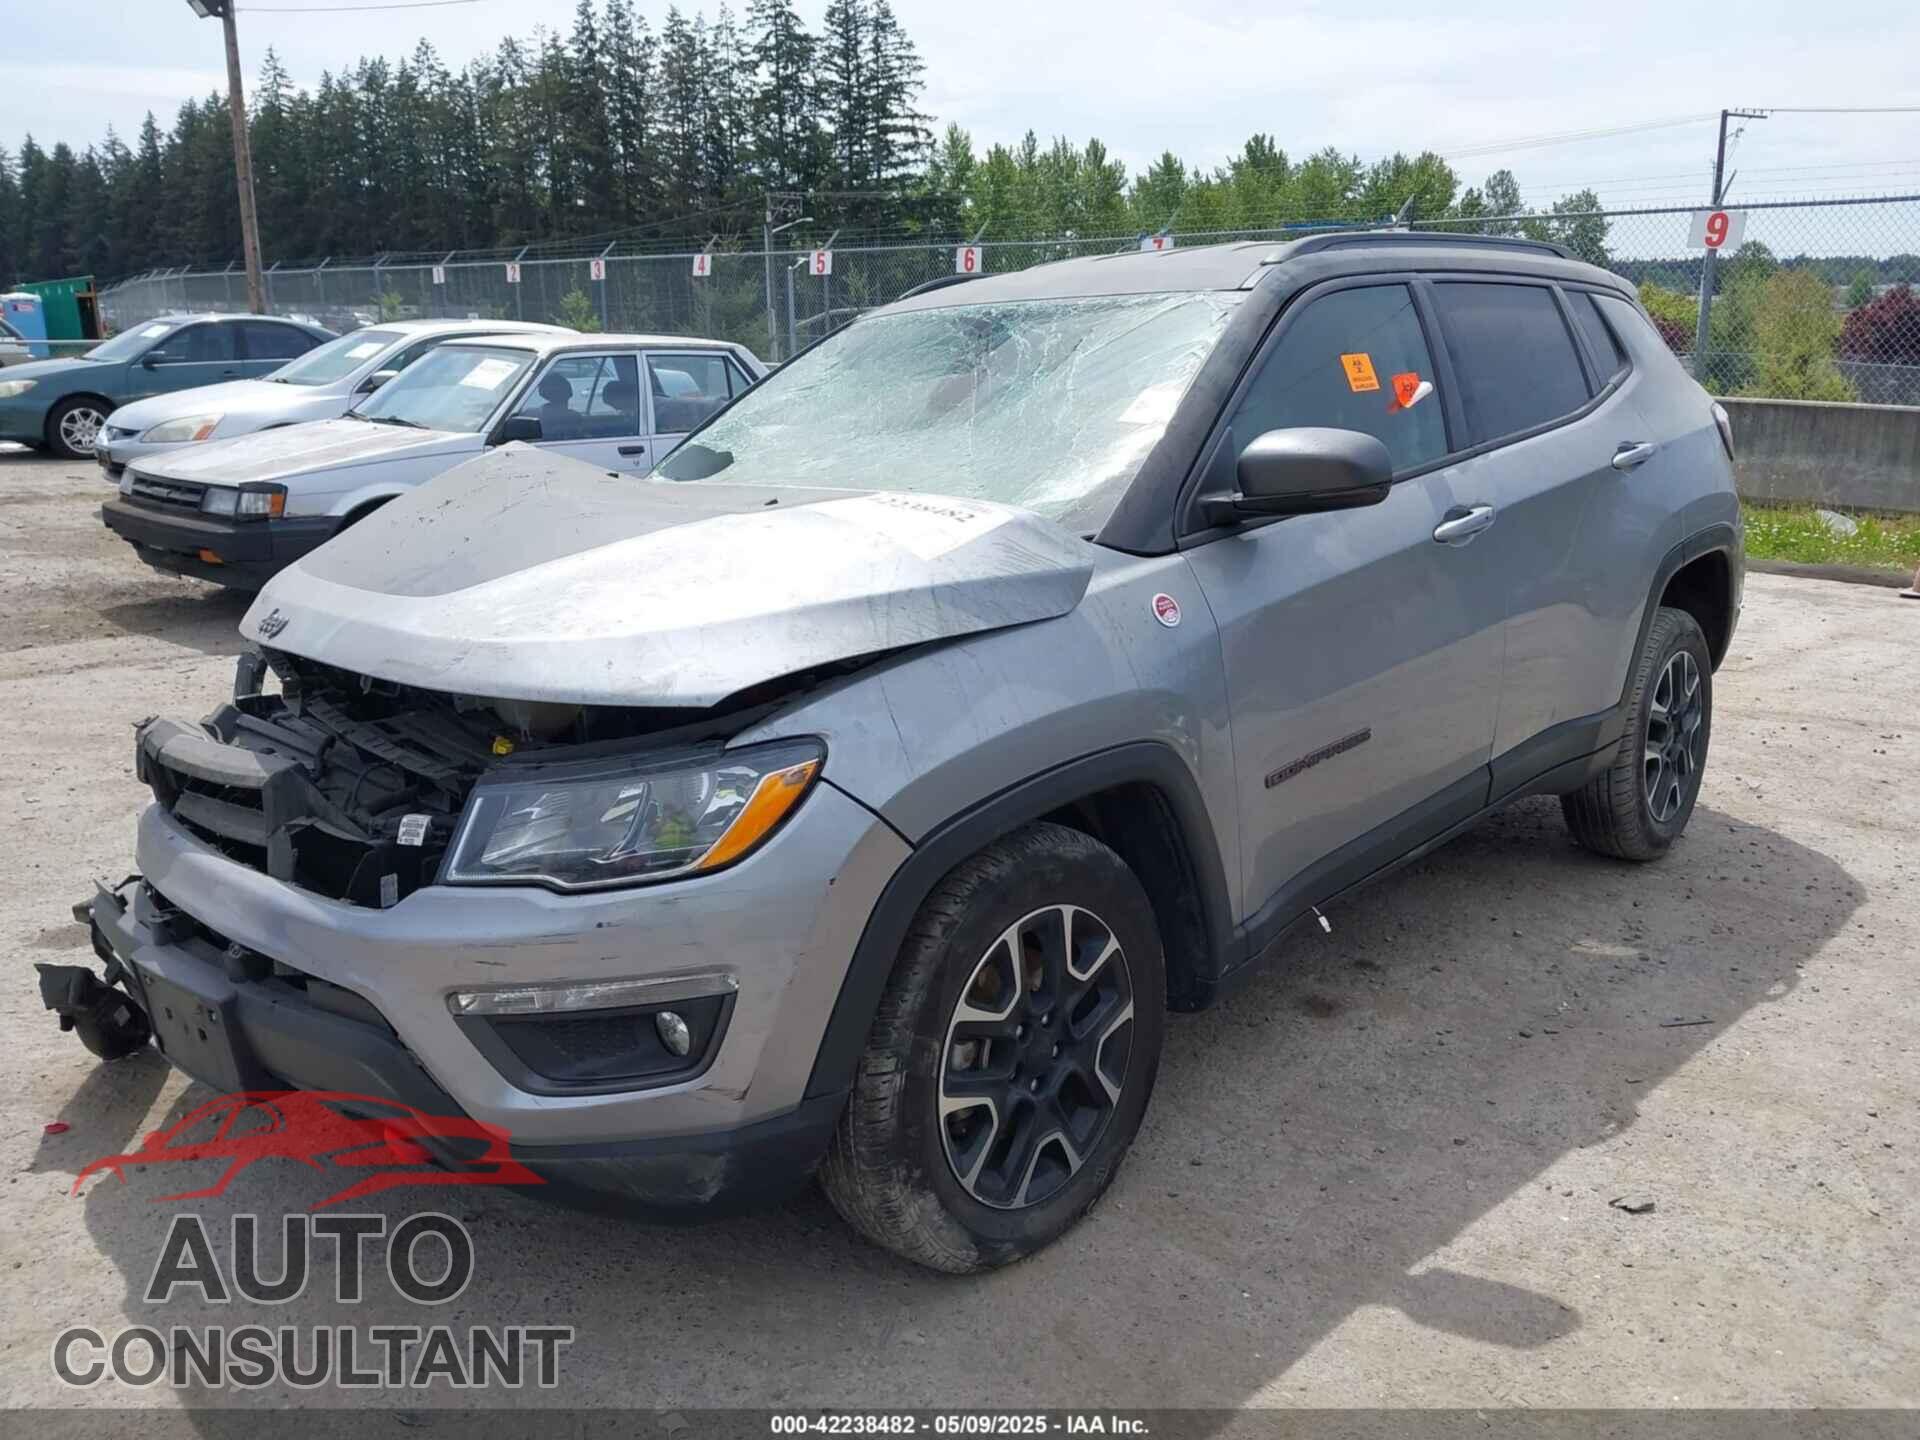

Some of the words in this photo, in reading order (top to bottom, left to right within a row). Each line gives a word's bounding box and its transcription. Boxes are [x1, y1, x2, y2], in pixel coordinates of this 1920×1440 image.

[1704, 212, 1729, 248] 9
[594, 261, 601, 278] 3
[697, 255, 705, 273] 4
[816, 252, 826, 273] 5
[964, 248, 975, 272] 6
